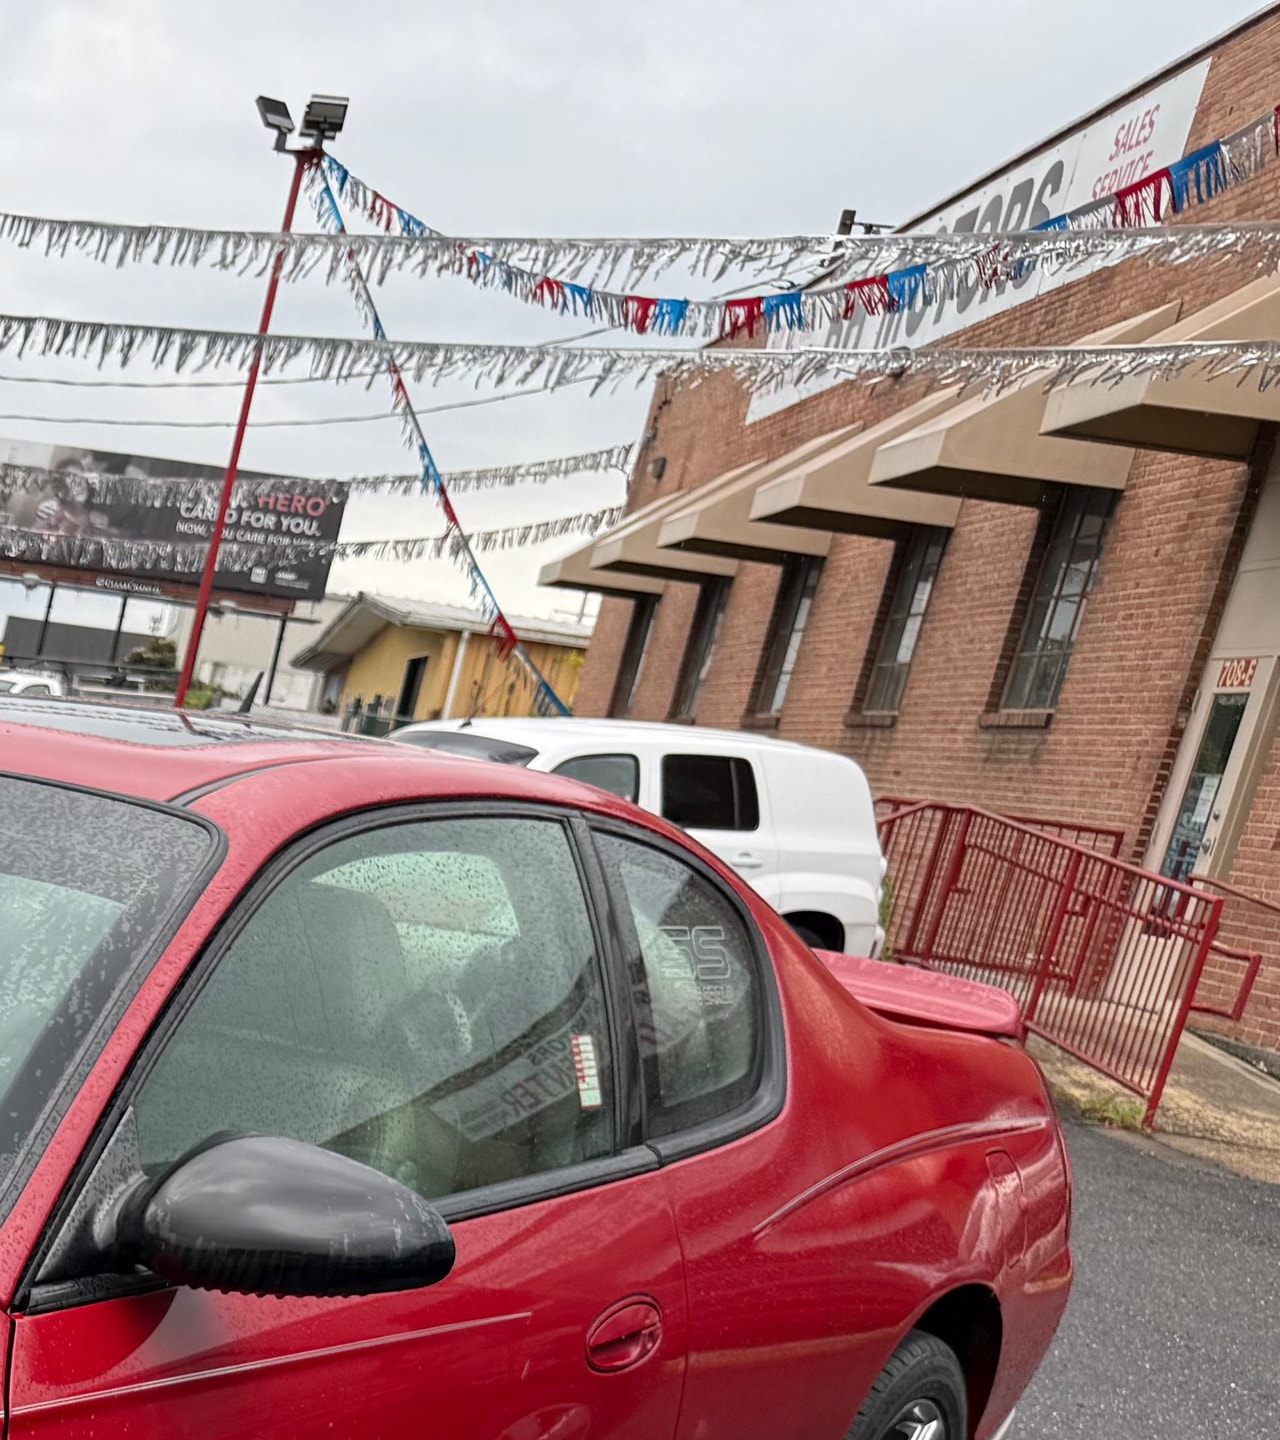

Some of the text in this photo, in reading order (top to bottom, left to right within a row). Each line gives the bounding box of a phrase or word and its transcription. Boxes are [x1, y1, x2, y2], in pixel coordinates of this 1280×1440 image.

[1108, 103, 1161, 163] SALES
[1091, 149, 1154, 201] SERVICE
[180, 501, 322, 538] CARD FOR YOU.
[258, 492, 326, 518] HERO
[1219, 658, 1257, 688] 708-E
